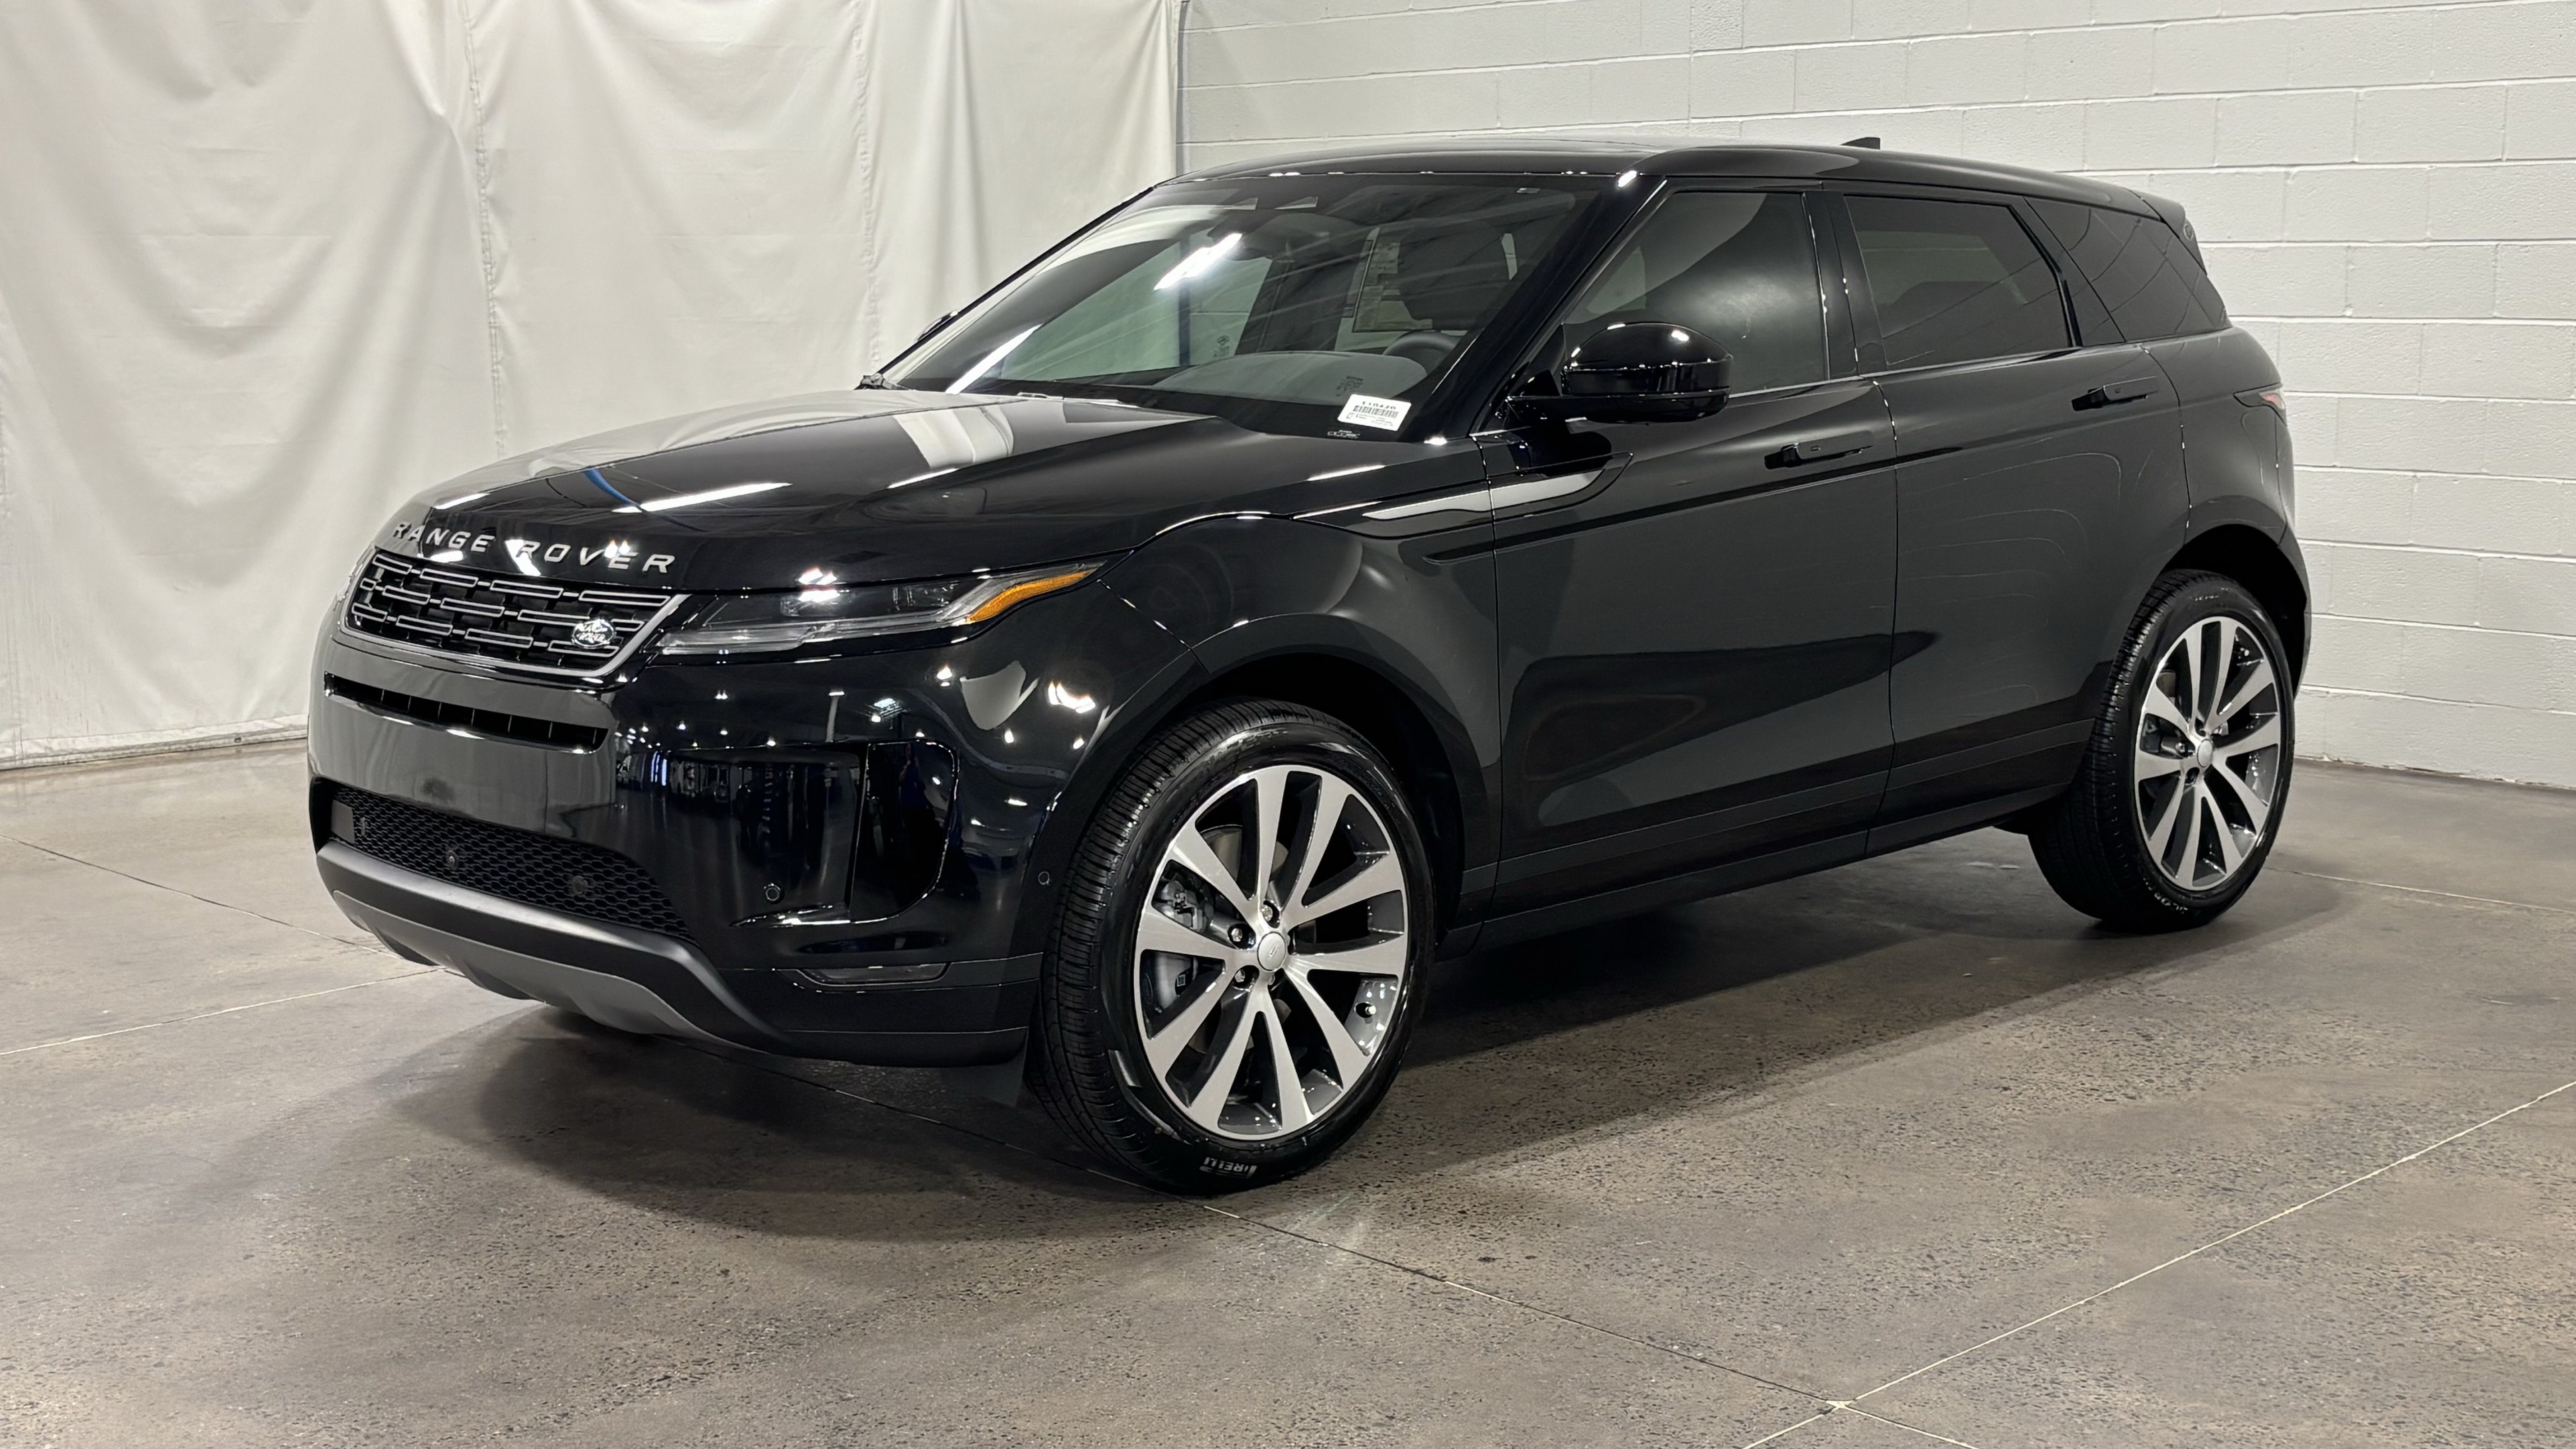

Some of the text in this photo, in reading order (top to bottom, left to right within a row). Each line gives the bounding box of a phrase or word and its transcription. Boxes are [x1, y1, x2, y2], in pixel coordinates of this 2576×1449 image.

[393, 522, 675, 573] RANGE ROVER
[1199, 1156, 1258, 1179] PIRELLI
